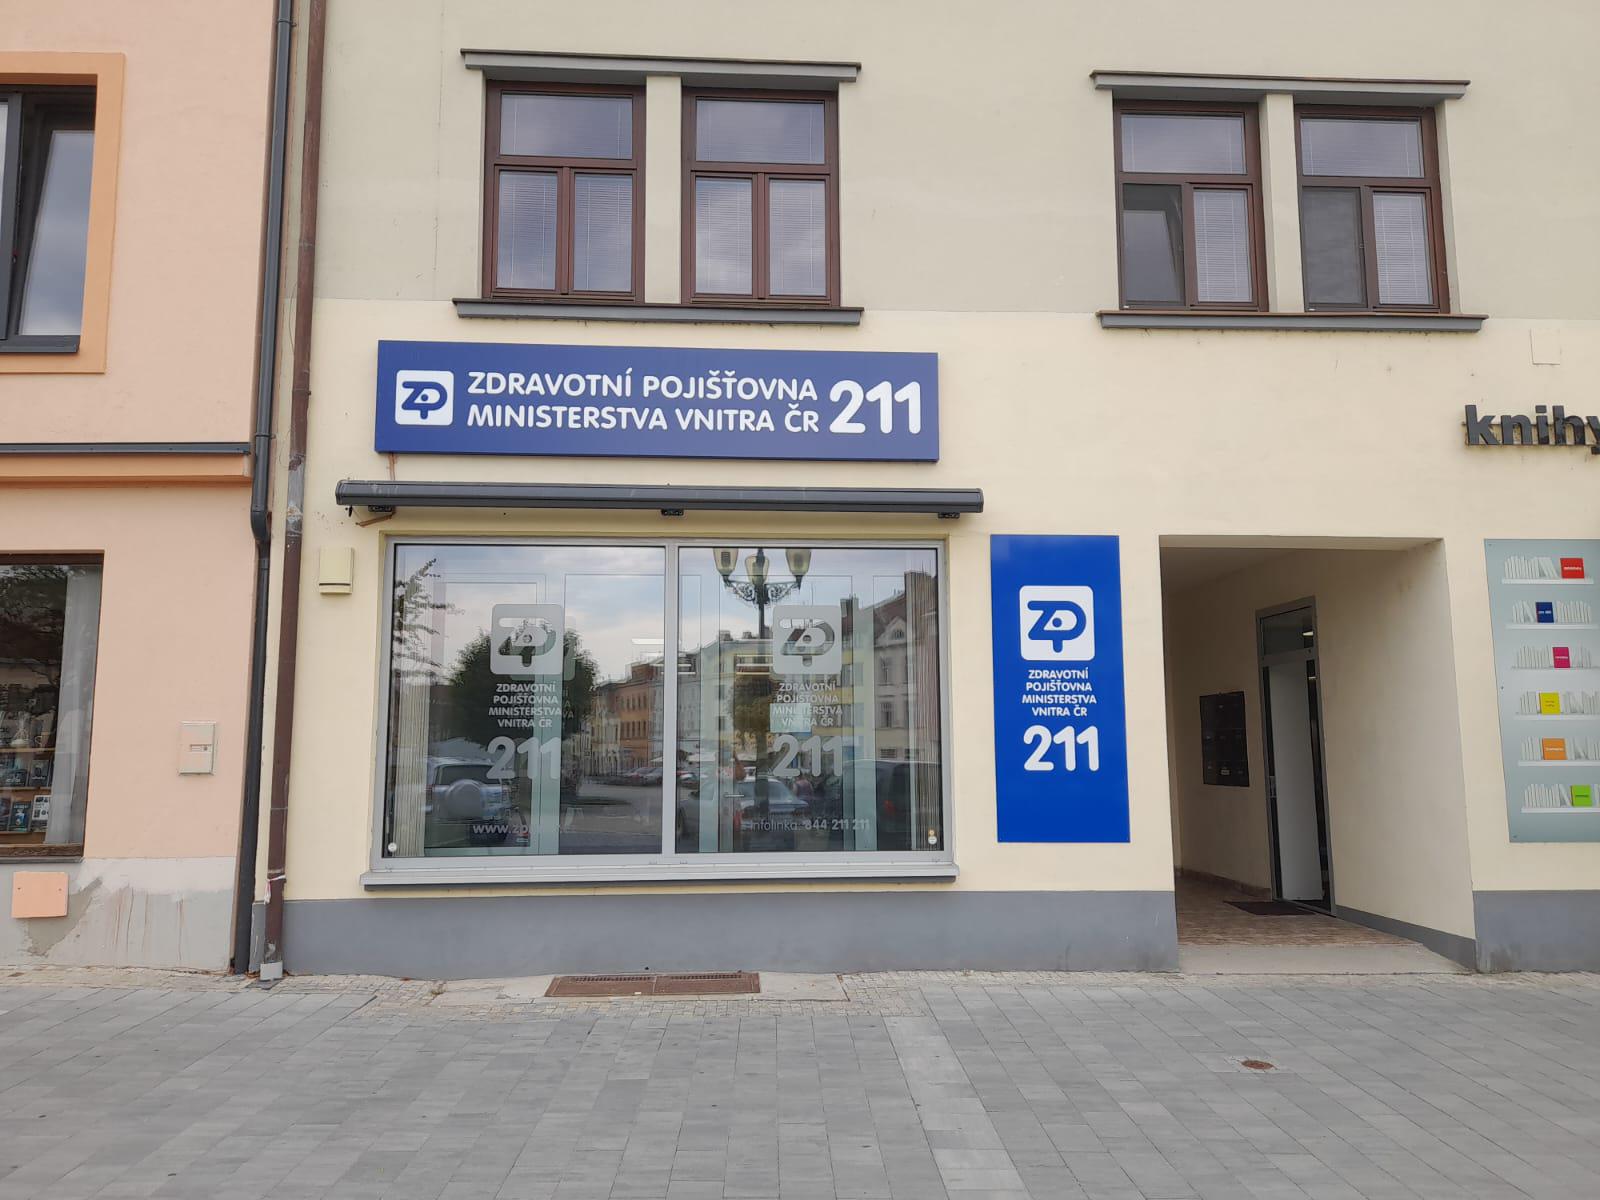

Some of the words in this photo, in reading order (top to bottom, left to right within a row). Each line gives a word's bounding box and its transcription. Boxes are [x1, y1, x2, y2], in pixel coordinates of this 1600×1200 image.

[467, 368, 633, 398] ZDRAVOTNÍ
[643, 370, 819, 400] POJIŠŤOVNA
[829, 379, 921, 434] 211
[467, 404, 669, 430] MINISTERSTVA
[675, 408, 775, 432] VNITRA
[784, 403, 819, 433] ČR
[1028, 667, 1089, 679] ZDRAVOTNÍ
[496, 681, 557, 692] ZDRAVOTNÍ
[1026, 680, 1092, 692] POJIŠŤOVNA
[493, 693, 559, 704] POJIŠŤOVNA
[1022, 694, 1097, 704] MINISTERSTVA
[488, 706, 562, 716] MINISTERSTVA
[1032, 706, 1070, 717] VNITRA
[1073, 704, 1088, 717] ČR
[497, 719, 536, 728] VNITRA
[538, 717, 553, 728] ČR
[1023, 724, 1100, 772] 211
[486, 736, 561, 779] 211
[773, 735, 842, 776] 211
